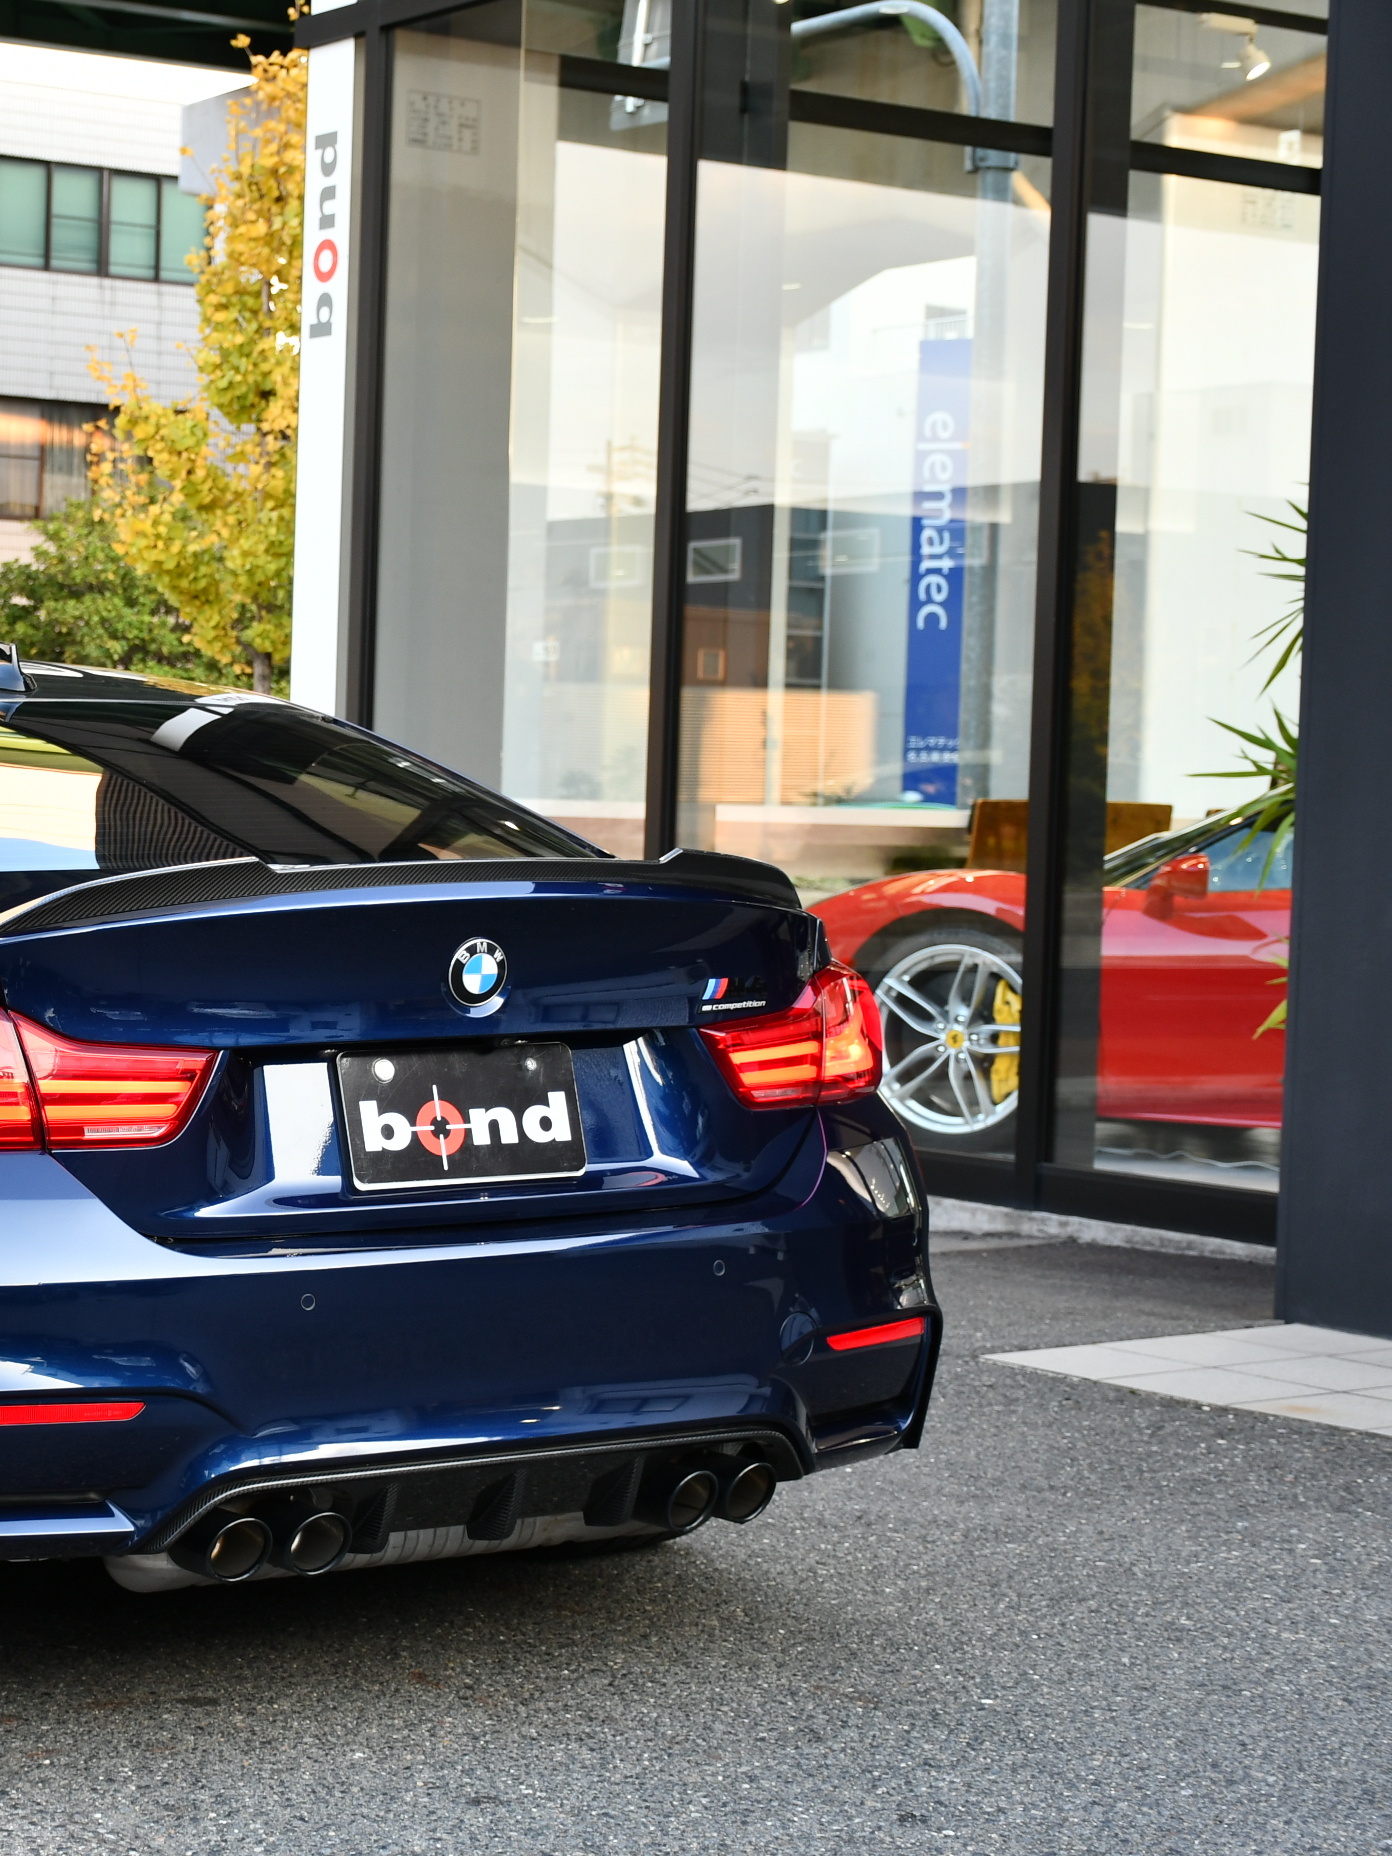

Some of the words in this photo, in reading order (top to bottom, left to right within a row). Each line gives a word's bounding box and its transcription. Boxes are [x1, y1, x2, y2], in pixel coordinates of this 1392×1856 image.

[309, 131, 338, 339] bond
[916, 409, 969, 631] elematec
[457, 941, 504, 964] BMW
[712, 1000, 766, 1010] competition
[359, 1090, 572, 1157] bond
